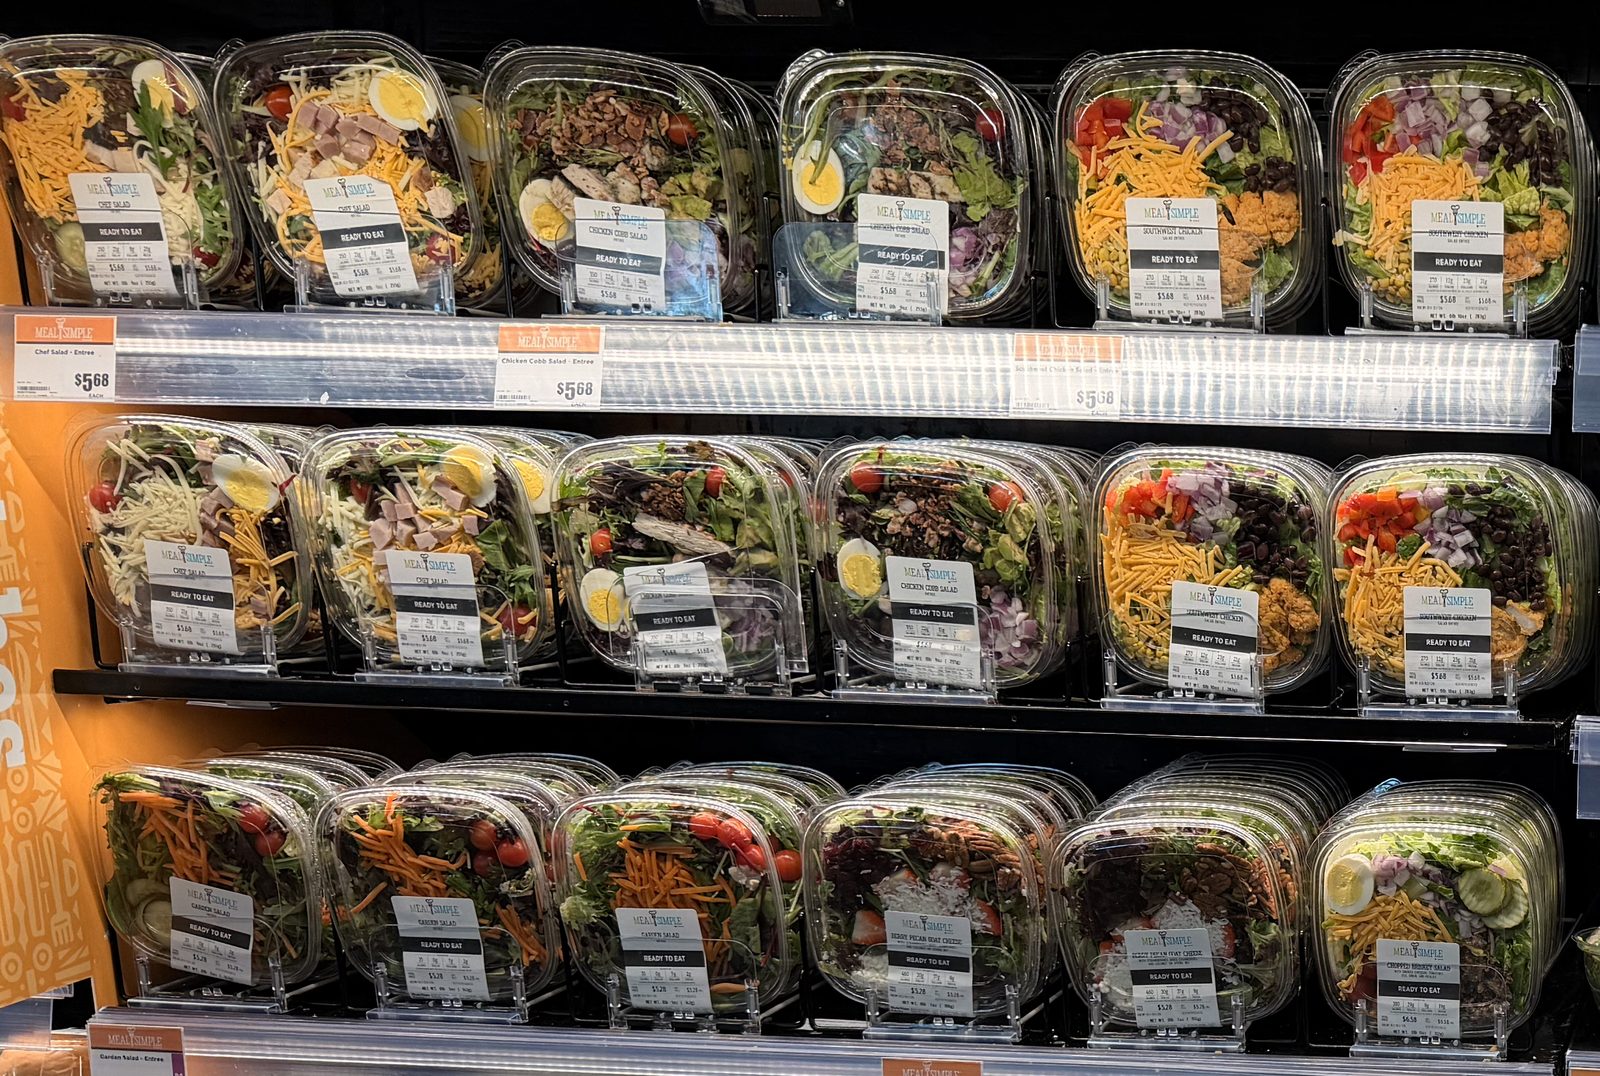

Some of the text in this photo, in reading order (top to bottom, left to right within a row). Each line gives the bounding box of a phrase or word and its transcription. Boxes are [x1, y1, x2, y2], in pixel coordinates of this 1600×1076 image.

[111, 184, 139, 194] SIMPLE
[347, 183, 375, 196] SIMPLE
[877, 206, 931, 221] MEAL SIMPLE
[1145, 208, 1199, 218] MEAL SIMPLE
[1431, 212, 1486, 224] MEAL SIMPLE
[341, 233, 362, 241] READY
[589, 226, 613, 235] CHICKEN
[630, 231, 647, 240] SALAD
[877, 251, 899, 259] READY
[596, 255, 618, 264] READY
[629, 259, 641, 267] EAT
[881, 287, 896, 295] $5.68
[34, 326, 93, 340] MEAL SIMPLE
[518, 337, 577, 348] MEAL SIMPLE
[186, 554, 213, 564] SIMPLE
[404, 559, 456, 571] MEAL SIMPLE
[904, 567, 957, 580] MEAL SIMPLE
[925, 584, 939, 592] COBB
[940, 585, 958, 593] SALAD
[171, 591, 191, 599] READY
[1190, 592, 1242, 607] MEAL SIMPLE
[1422, 596, 1474, 606] MEAL SIMPLE
[910, 608, 931, 616] READY
[1192, 634, 1213, 643] READY
[1225, 638, 1236, 646] EAT
[211, 895, 238, 908] SIMPLE
[213, 908, 231, 917] SALAD
[434, 905, 459, 914] SIMPLE
[656, 916, 683, 925] SIMPLE
[189, 924, 209, 933] READY
[220, 932, 232, 940] EAT
[927, 922, 953, 932] SIMPLE
[1142, 936, 1192, 946] MEAL SIMPLE
[1393, 947, 1443, 958] MEAL SIMPLE
[906, 956, 927, 964] READY
[911, 987, 926, 995] $5.28
[108, 1034, 162, 1046] MEAL SIMPLE
